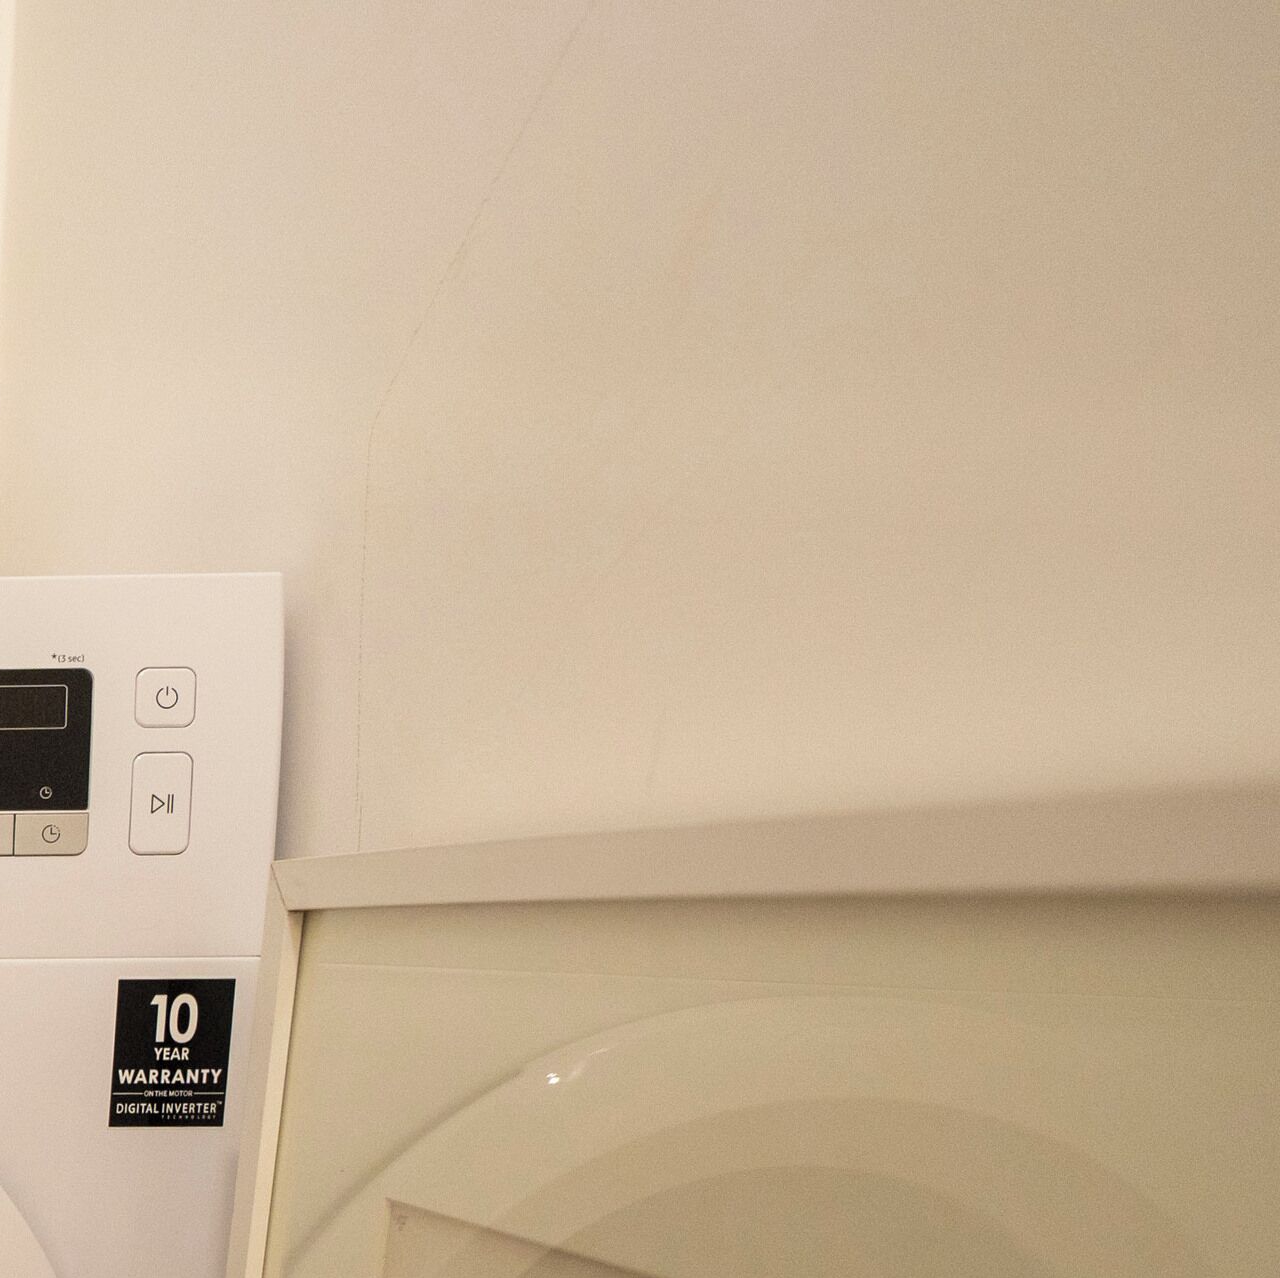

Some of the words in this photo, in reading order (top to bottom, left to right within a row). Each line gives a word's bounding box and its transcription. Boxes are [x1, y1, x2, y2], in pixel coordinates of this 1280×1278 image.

[150, 992, 199, 1044] 10
[154, 1047, 190, 1061] YEAR
[118, 1068, 222, 1084] WARRANTY
[168, 1089, 193, 1097] MOTOR
[116, 1103, 160, 1114] DIGITAL
